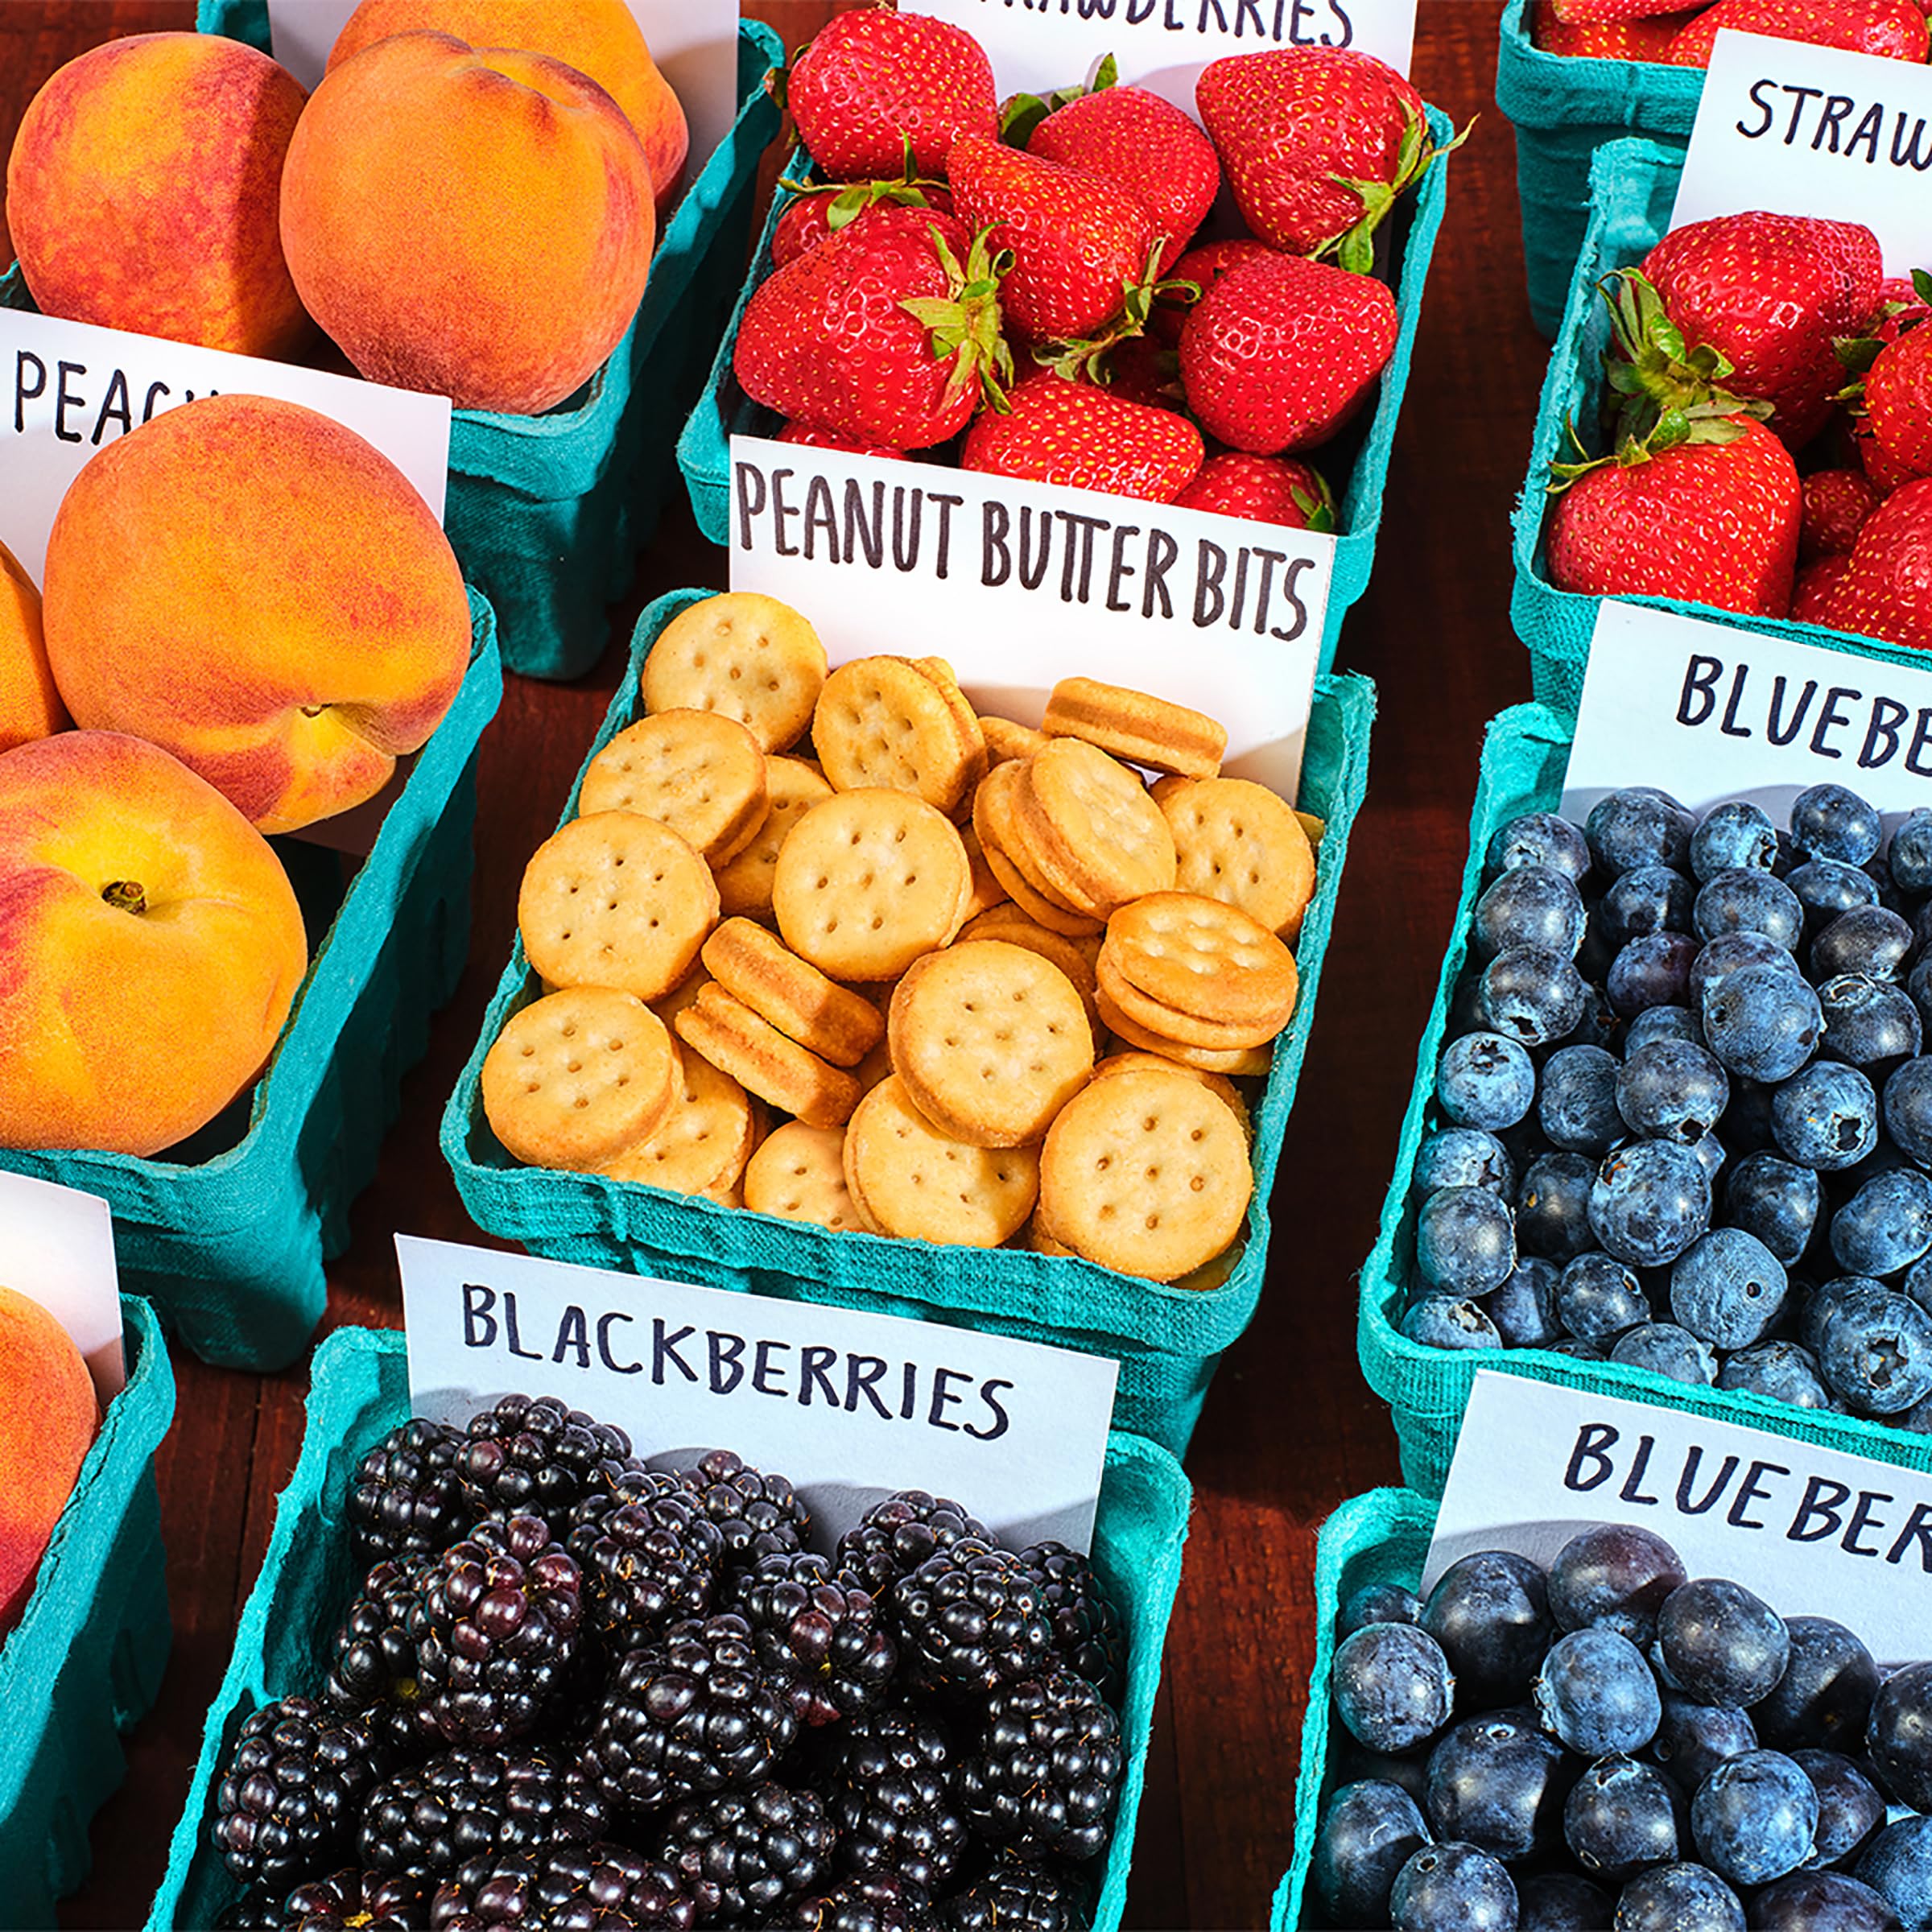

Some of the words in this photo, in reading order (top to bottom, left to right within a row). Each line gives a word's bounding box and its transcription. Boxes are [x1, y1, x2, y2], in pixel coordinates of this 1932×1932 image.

[1736, 79, 1932, 171] STRAW
[14, 349, 219, 446] PEAC
[735, 461, 964, 580] PEANUT
[980, 500, 1179, 620] BUTTER
[1192, 539, 1315, 642] BITS
[461, 1283, 1015, 1441] BLACKBERRIES
[1563, 1423, 1932, 1575] BLUEBER
